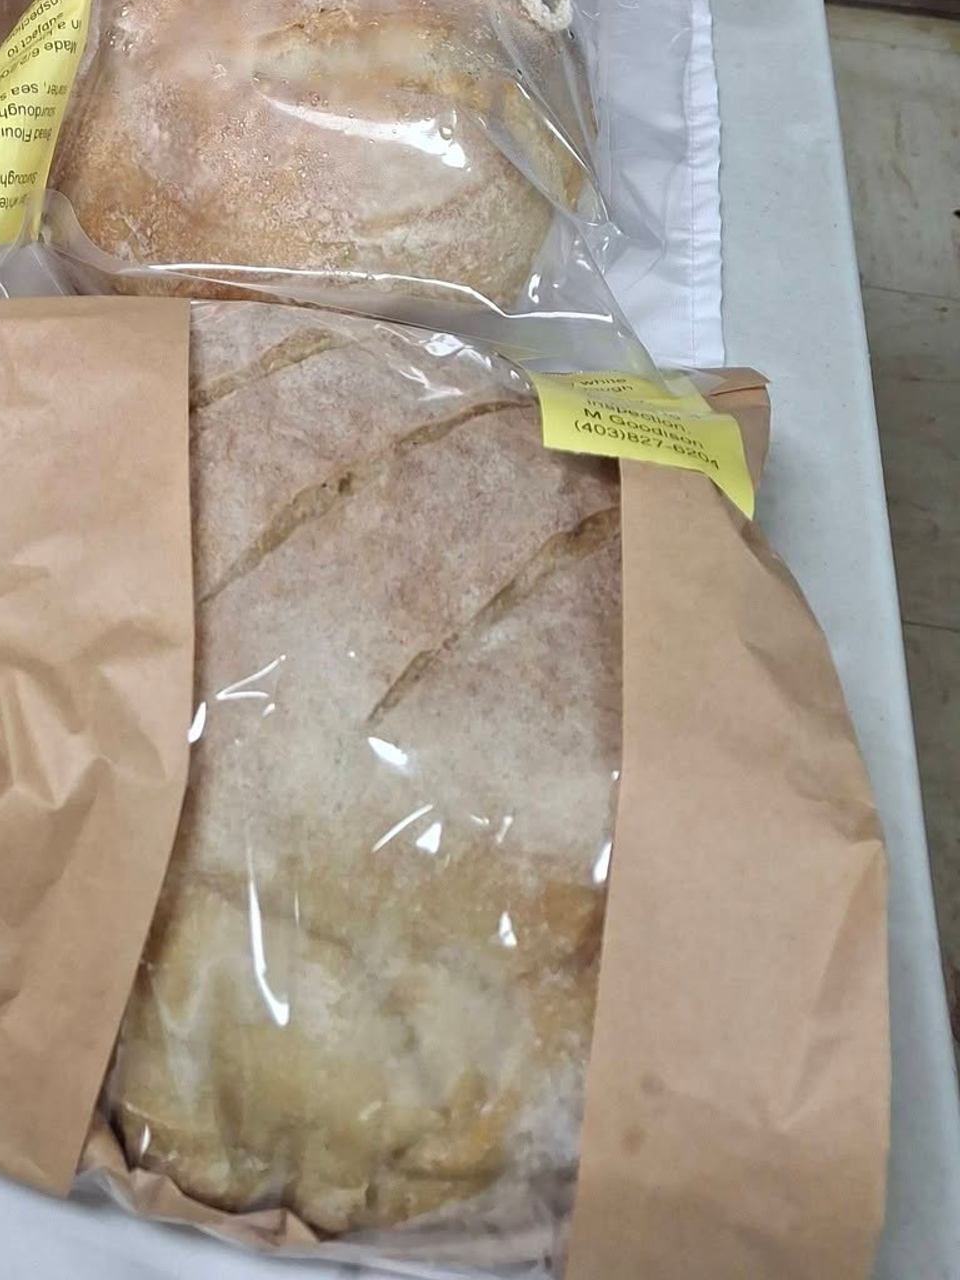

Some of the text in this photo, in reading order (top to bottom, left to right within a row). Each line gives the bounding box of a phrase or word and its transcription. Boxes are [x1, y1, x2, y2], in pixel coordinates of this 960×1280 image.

[11, 83, 39, 96] sea
[574, 420, 720, 470] (403)827-6204
[583, 408, 602, 421] M
[608, 414, 705, 449] Goodison
